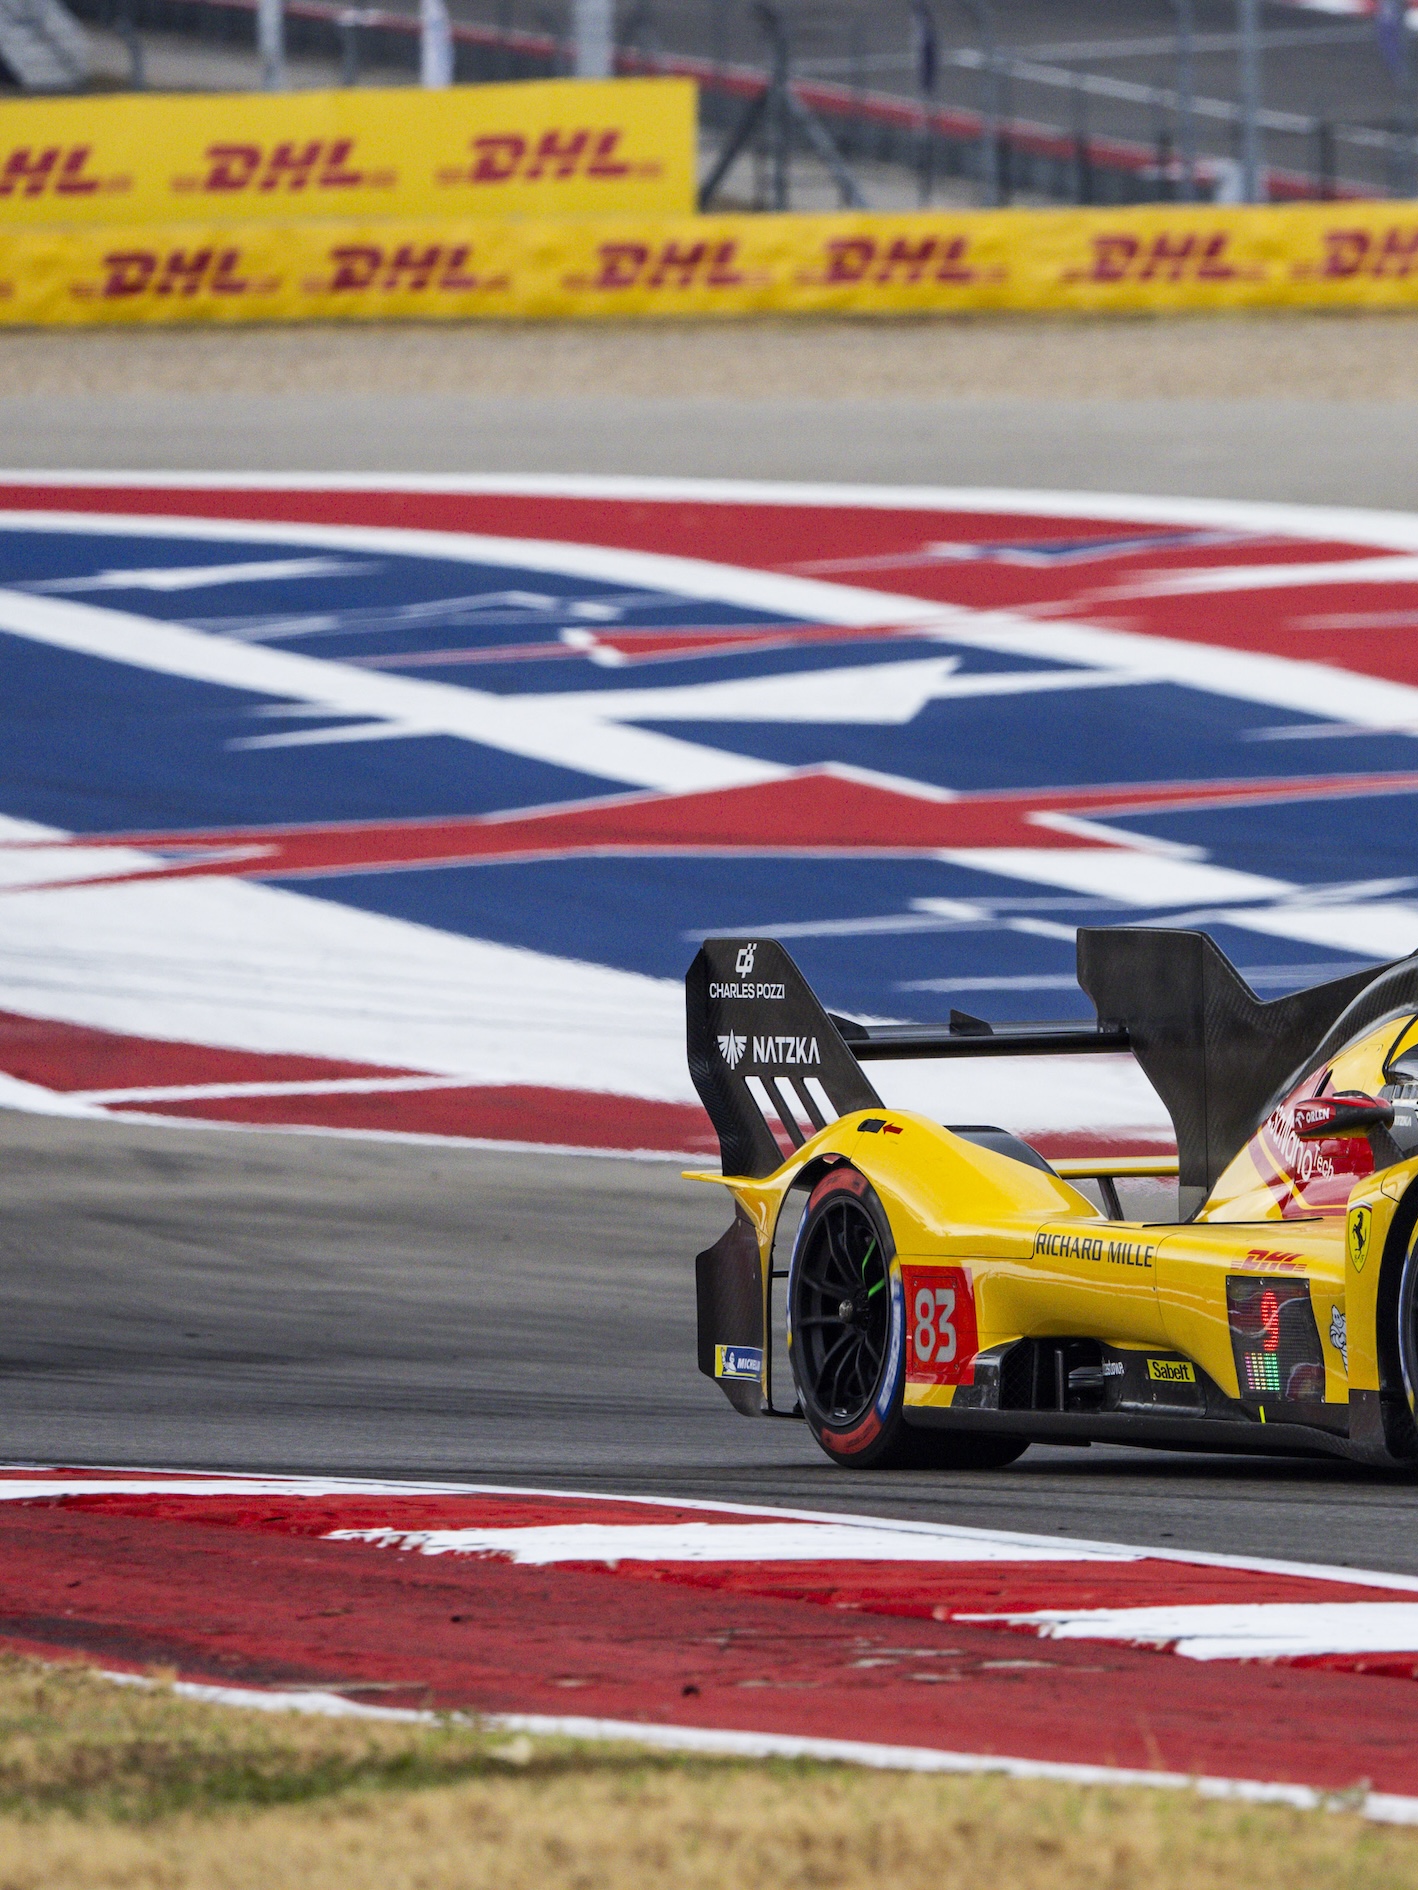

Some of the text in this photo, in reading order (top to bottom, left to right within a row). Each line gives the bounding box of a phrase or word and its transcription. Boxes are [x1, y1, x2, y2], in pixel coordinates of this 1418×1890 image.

[0, 146, 98, 196] HL
[203, 138, 363, 193] DHL
[468, 129, 629, 183] DHL
[102, 247, 247, 298] DHL
[328, 243, 476, 290] DHL
[593, 238, 741, 289] DHL
[824, 235, 973, 284] DHL
[1091, 232, 1235, 283] DHL
[709, 983, 785, 999] CHARLES POZZI
[753, 1036, 821, 1064] NATZKA
[1306, 1107, 1330, 1124] ORLEN
[1036, 1233, 1154, 1268] RICHARD MILLE
[1240, 1249, 1304, 1271] DHL
[914, 1288, 957, 1363] 83
[1152, 1361, 1190, 1380] Sabelt
